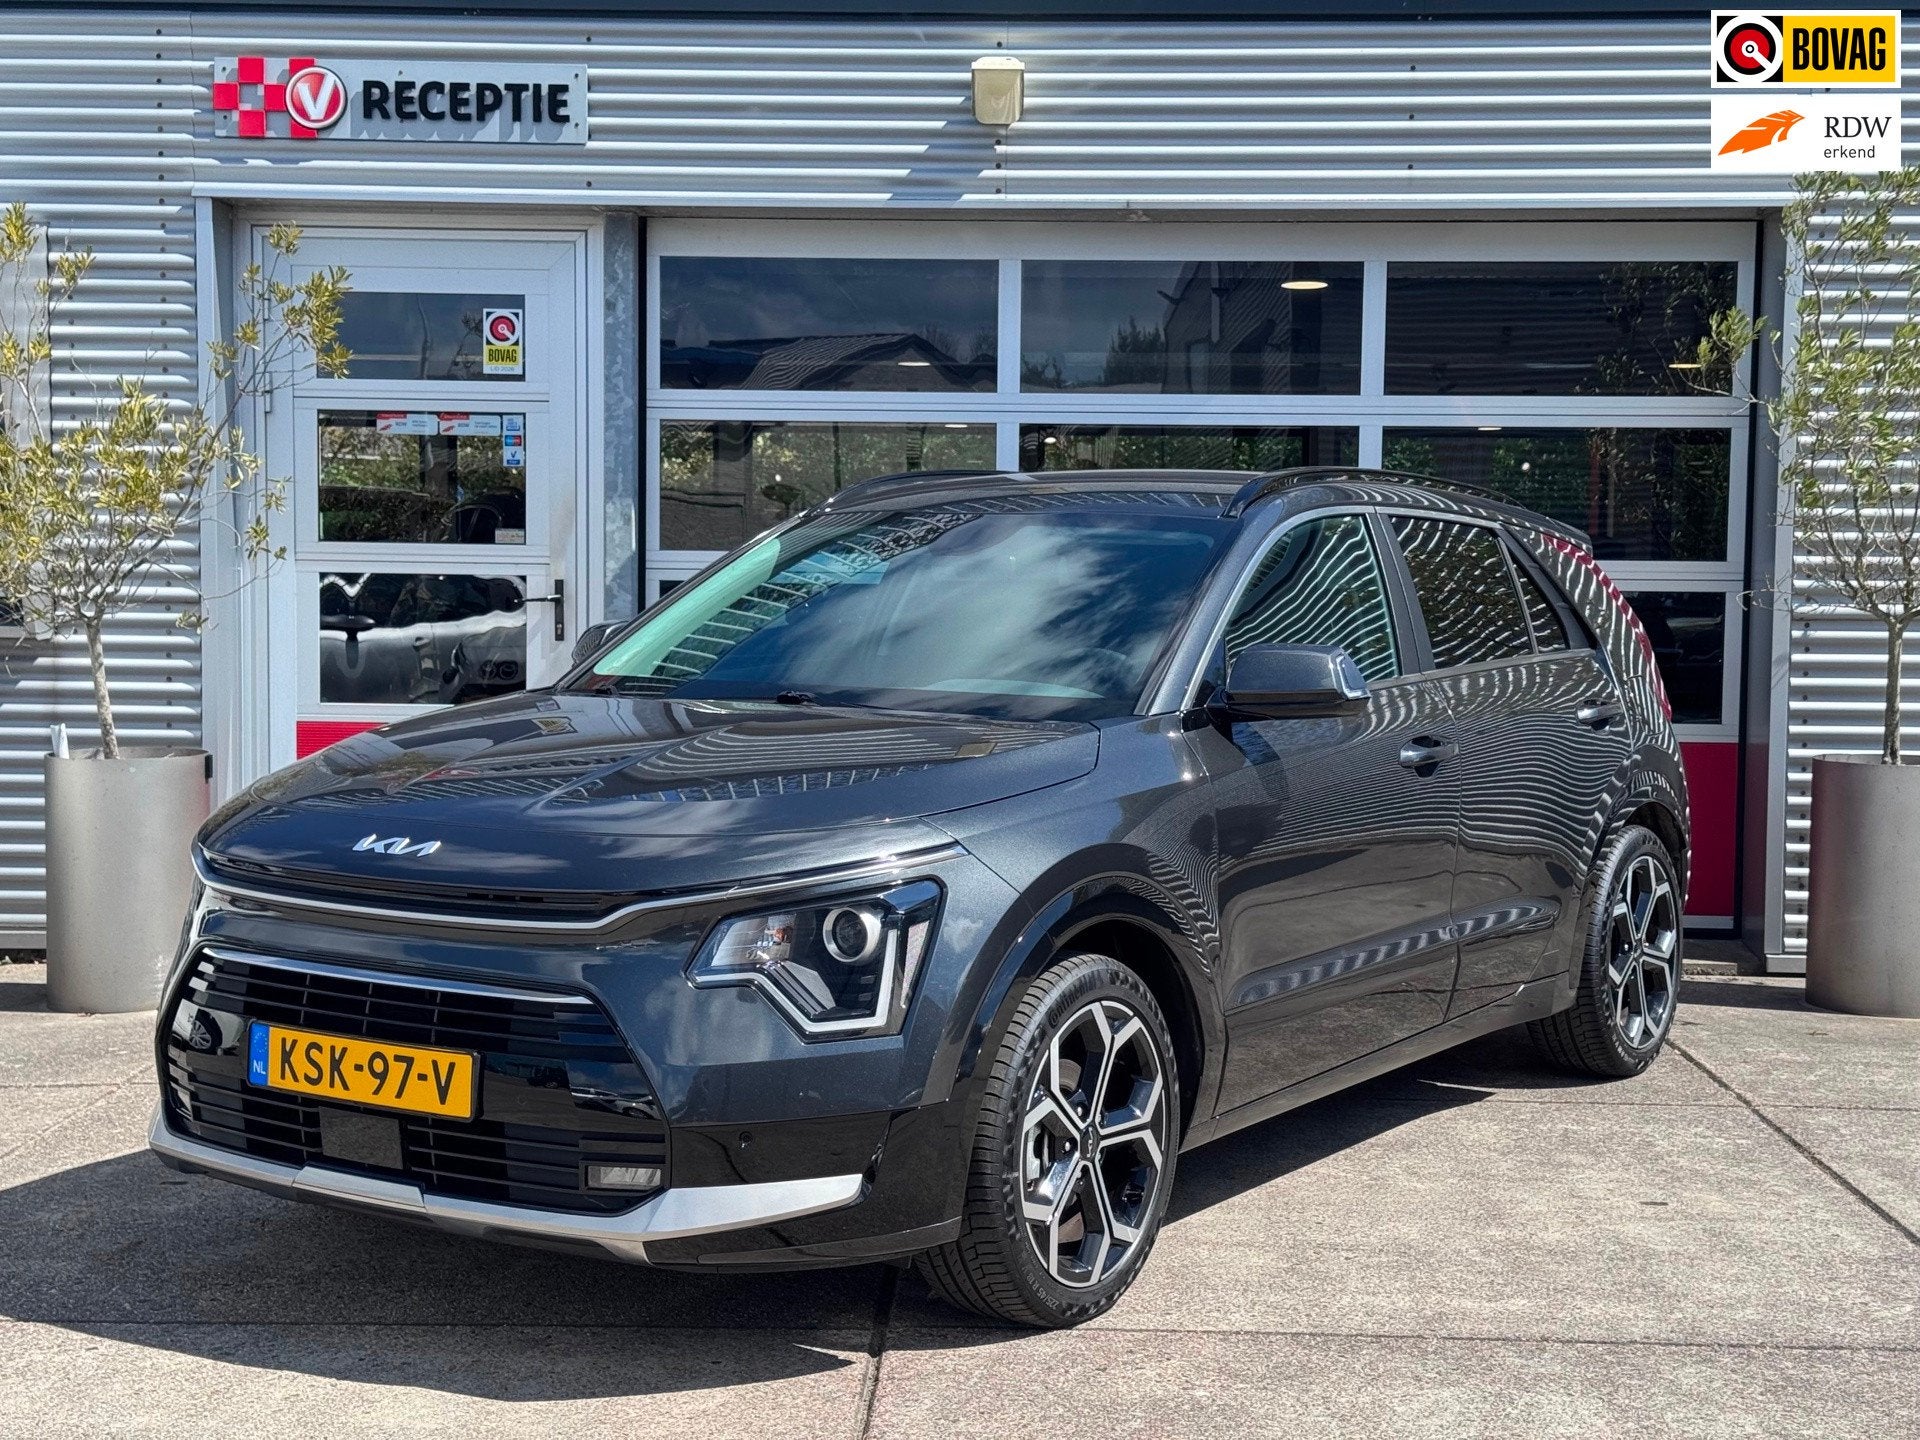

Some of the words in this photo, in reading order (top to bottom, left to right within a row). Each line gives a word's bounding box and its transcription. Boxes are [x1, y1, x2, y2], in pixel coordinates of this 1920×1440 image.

[297, 77, 336, 121] V
[362, 79, 571, 124] RECEPTIE
[488, 348, 517, 363] BOVAG
[352, 833, 442, 857] KIA
[253, 1060, 266, 1074] NL
[280, 1036, 456, 1106] KSK-97-V
